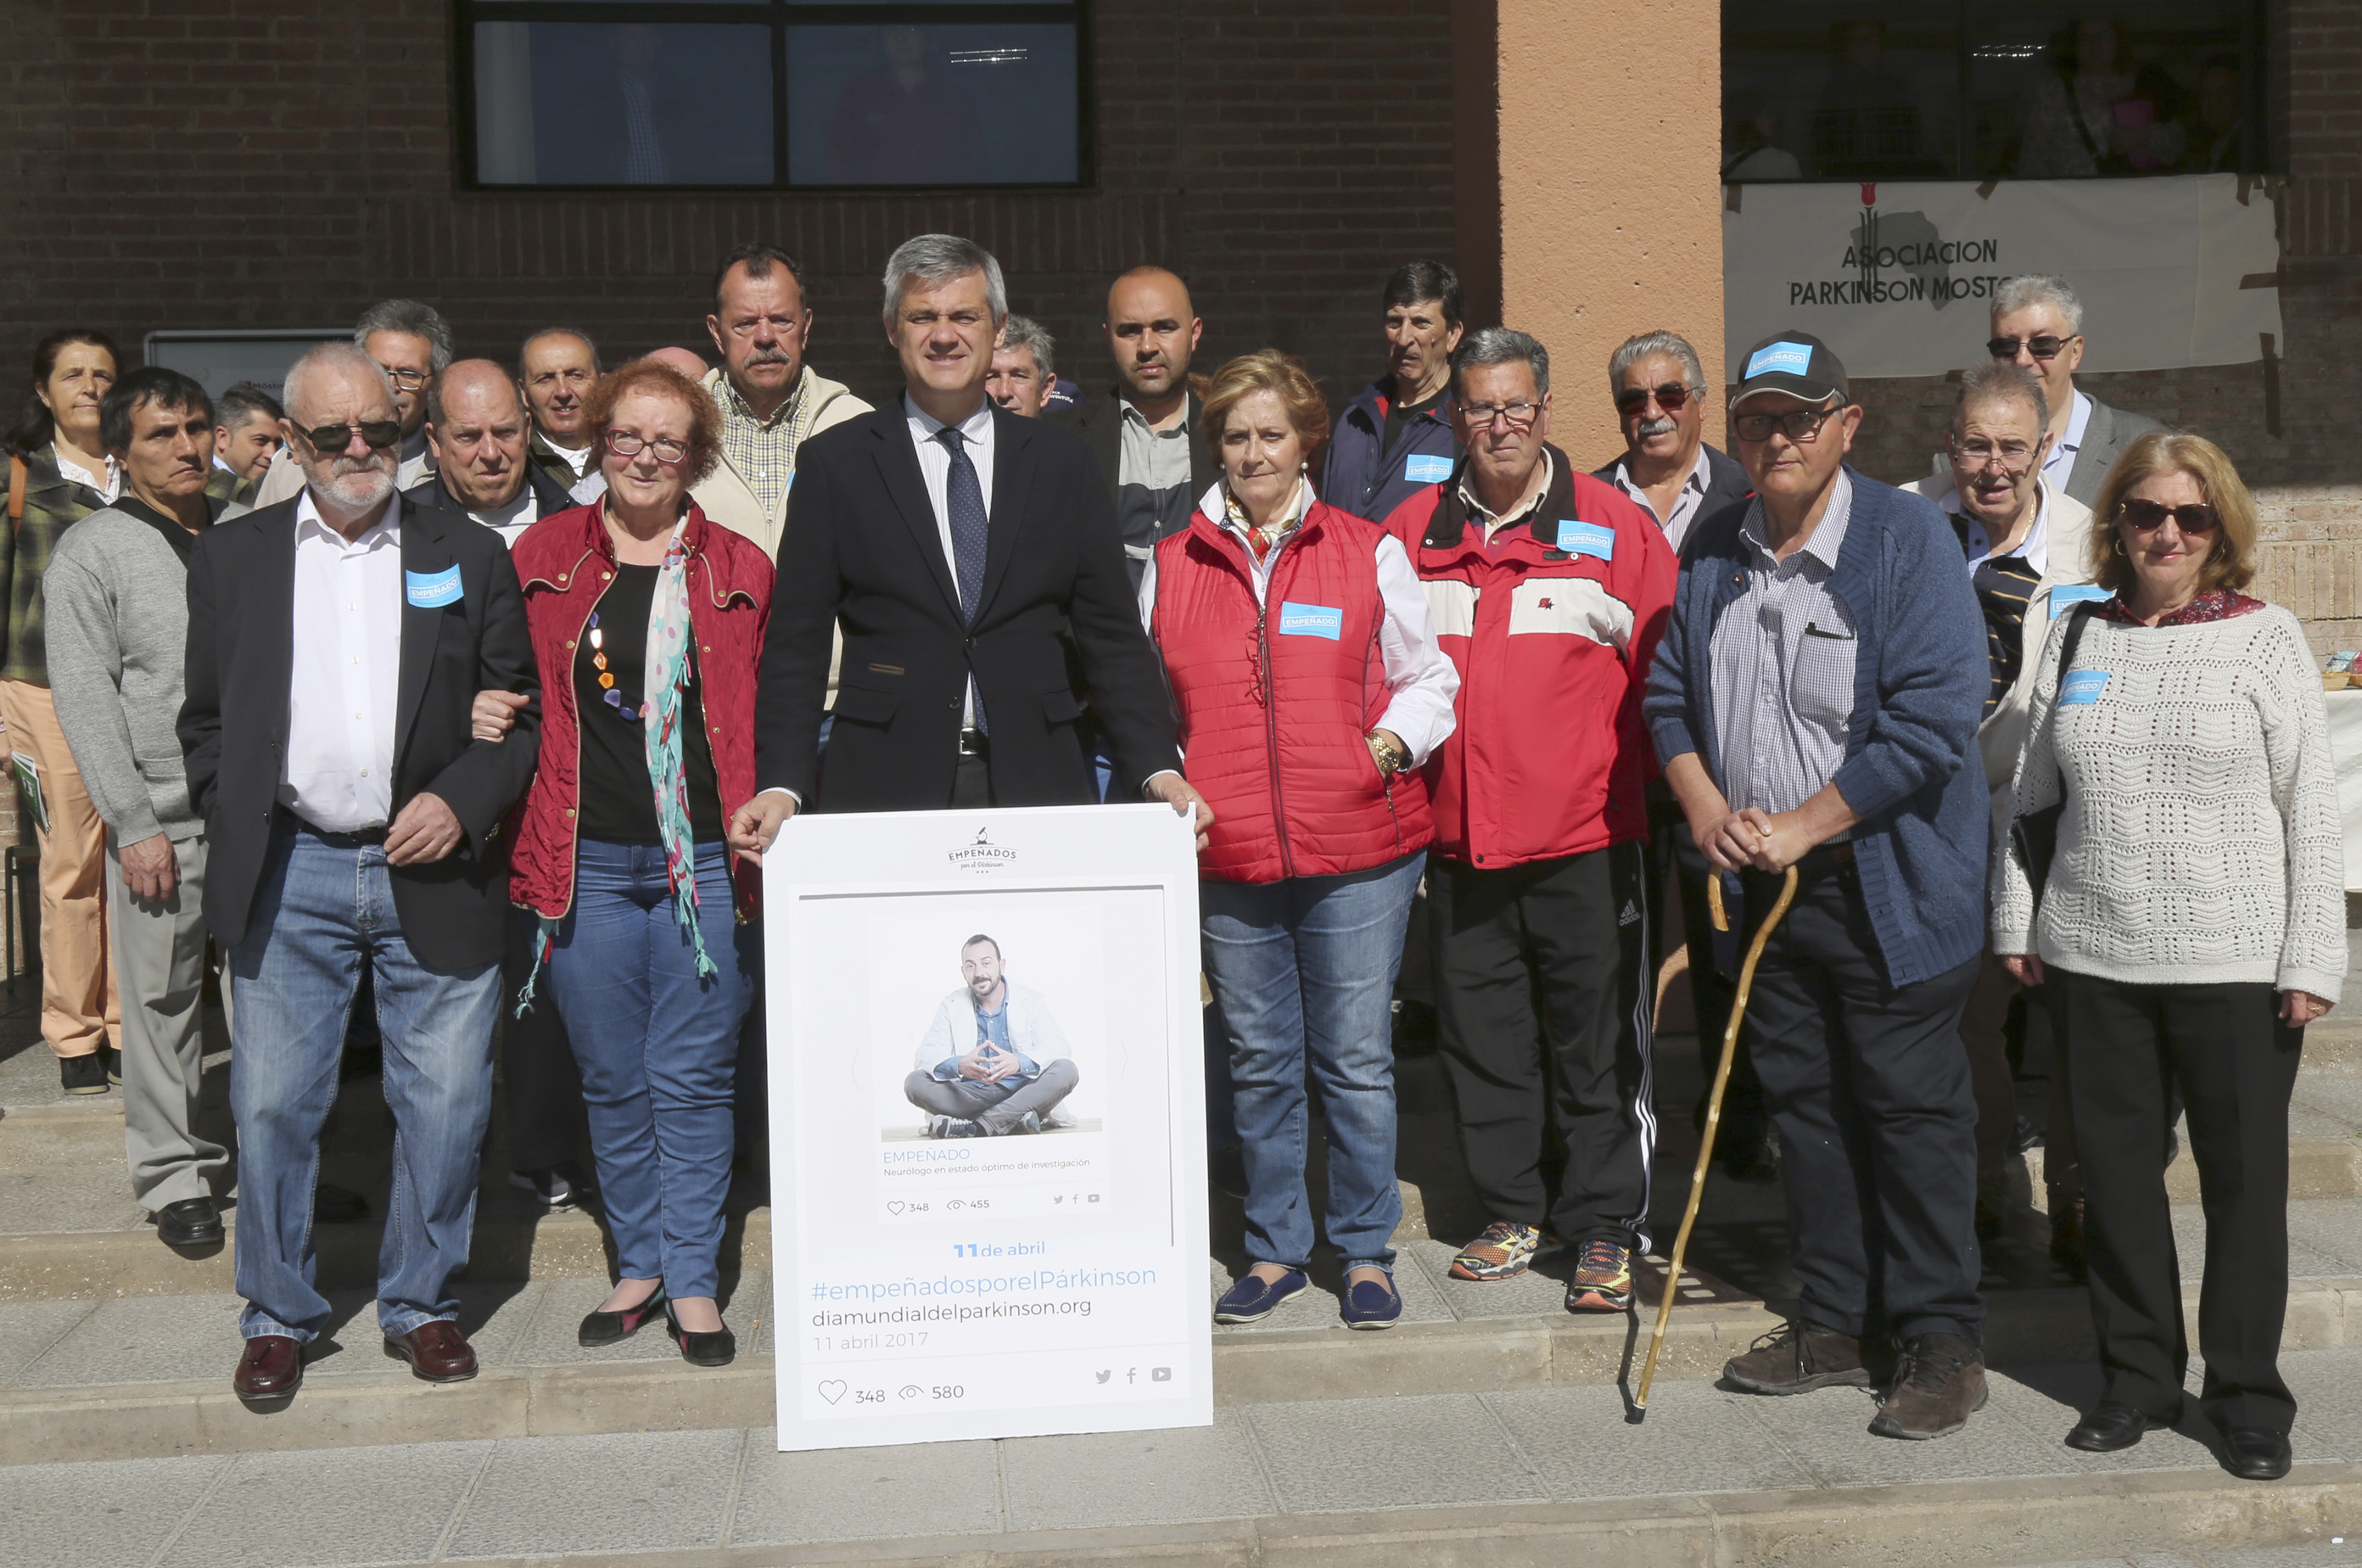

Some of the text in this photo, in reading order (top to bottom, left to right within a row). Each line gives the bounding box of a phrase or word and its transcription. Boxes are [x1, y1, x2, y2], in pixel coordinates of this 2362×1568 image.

[1842, 239, 1997, 268] ASOCIACION
[1932, 276, 2014, 300] MOST
[949, 847, 1016, 860] EMPEÑADOS
[883, 1147, 971, 1163] EMPEÑADO
[884, 1167, 932, 1176] Neurólogo
[949, 1164, 979, 1173] estado
[981, 1162, 1015, 1173] óptimo
[1032, 1158, 1090, 1169] investigación
[909, 1200, 990, 1212] 348 455
[954, 1241, 1045, 1257] 11 de abril
[811, 1268, 1156, 1302] #empeñadosporelPárkinson
[812, 1300, 1091, 1327] diamundialdelparkinson.org
[814, 1331, 928, 1351] 11 abril 2017
[855, 1385, 964, 1403] 348 580
